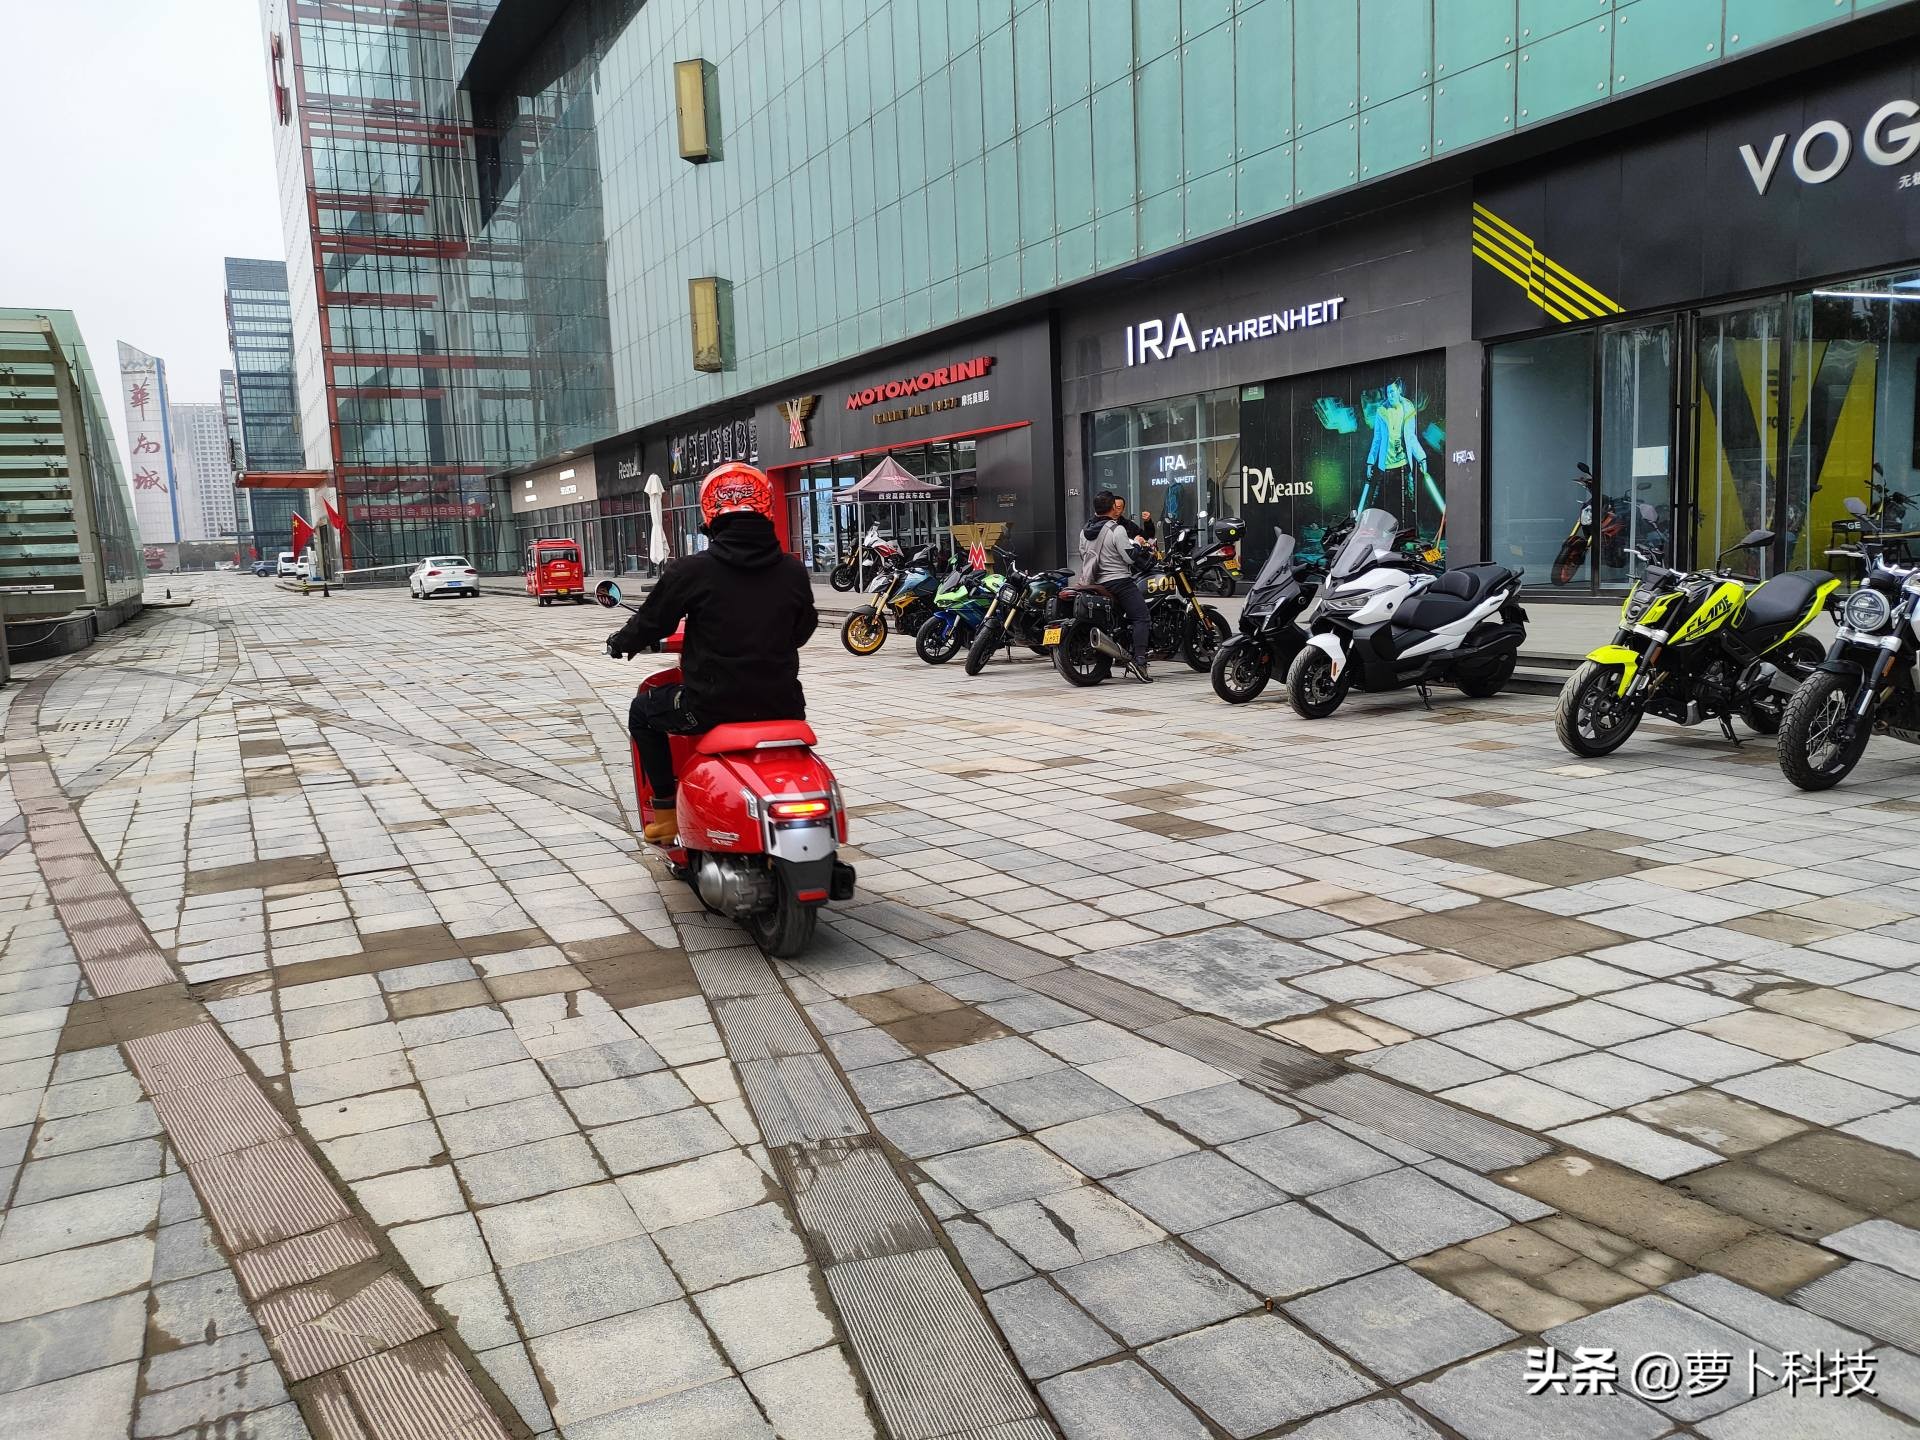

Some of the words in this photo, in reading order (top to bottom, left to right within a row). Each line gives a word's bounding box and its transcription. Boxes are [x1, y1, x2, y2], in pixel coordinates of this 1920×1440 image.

[1739, 100, 1920, 195] VOG
[1126, 312, 1197, 366] IRA
[1201, 297, 1344, 350] FAHRENHEIT
[845, 356, 986, 411] MOTOMORINI
[1159, 454, 1187, 473] IRA
